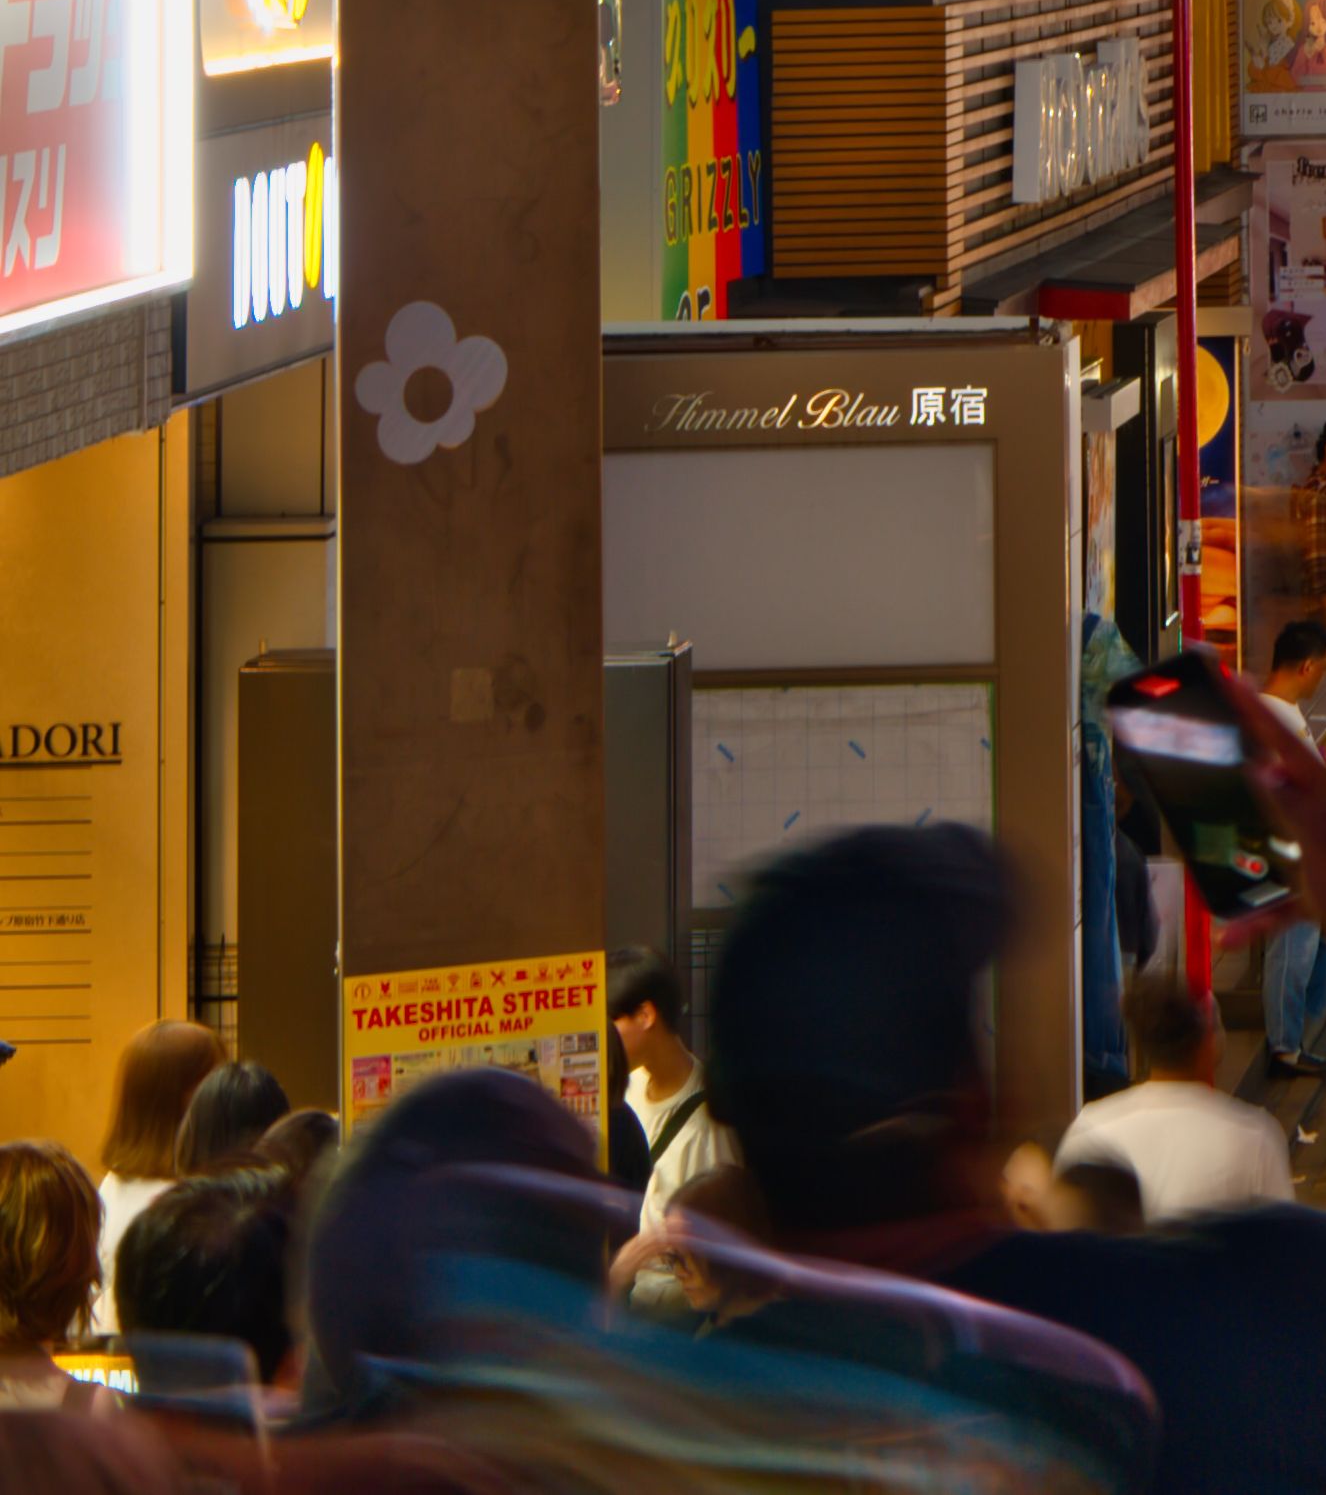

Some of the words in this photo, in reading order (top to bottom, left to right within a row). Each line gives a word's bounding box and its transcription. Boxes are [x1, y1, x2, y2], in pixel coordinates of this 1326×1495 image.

[664, 150, 762, 247] GRIZZLY
[797, 387, 903, 430] Blau
[909, 385, 989, 427] 原宿
[352, 996, 495, 1031] TAKESHITA
[502, 984, 598, 1015] STREET
[417, 1022, 494, 1043] OFFICIAL
[499, 1016, 535, 1034] MAP
